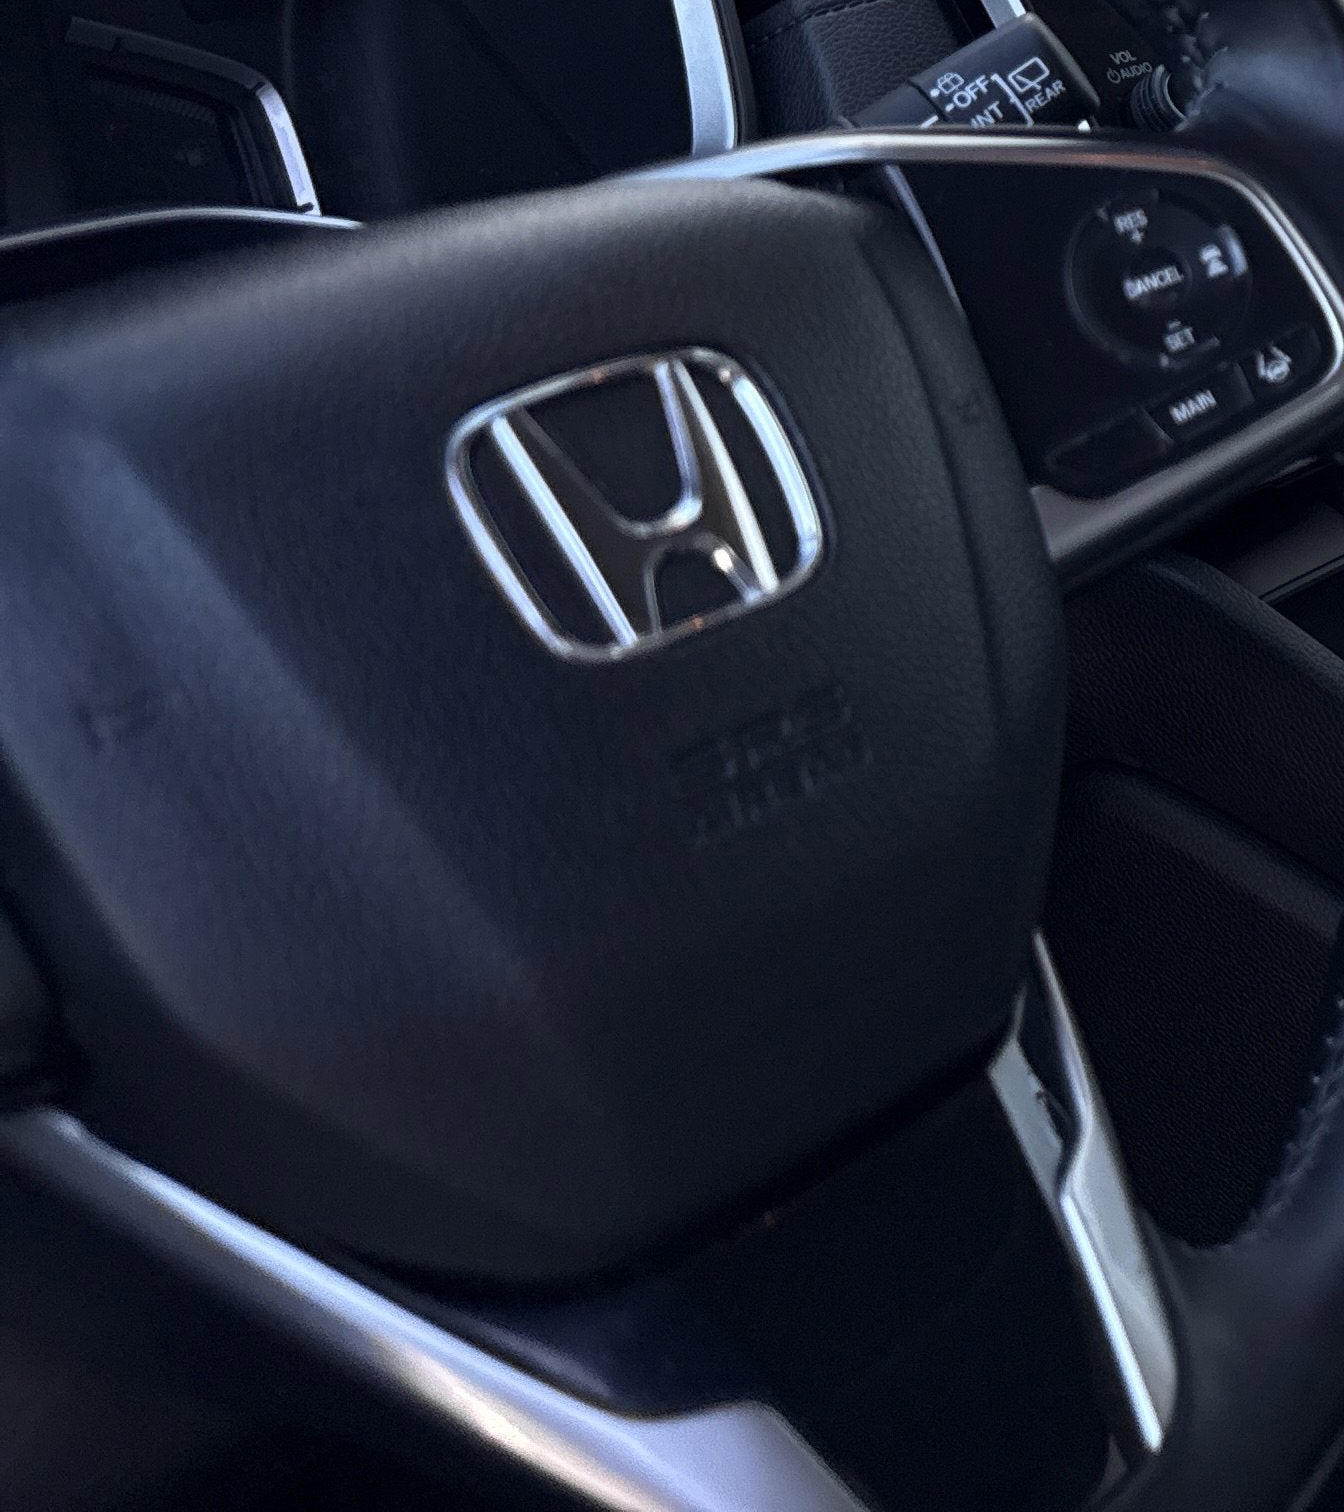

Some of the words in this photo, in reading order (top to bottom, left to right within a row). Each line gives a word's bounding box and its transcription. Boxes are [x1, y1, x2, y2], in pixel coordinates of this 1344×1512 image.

[1108, 49, 1138, 65] VOL
[1120, 61, 1153, 80] AUDIO
[953, 74, 991, 109] OFF
[1025, 79, 1067, 114] REAR
[1122, 264, 1185, 301] CANCEL
[1168, 388, 1218, 426] MAIN
